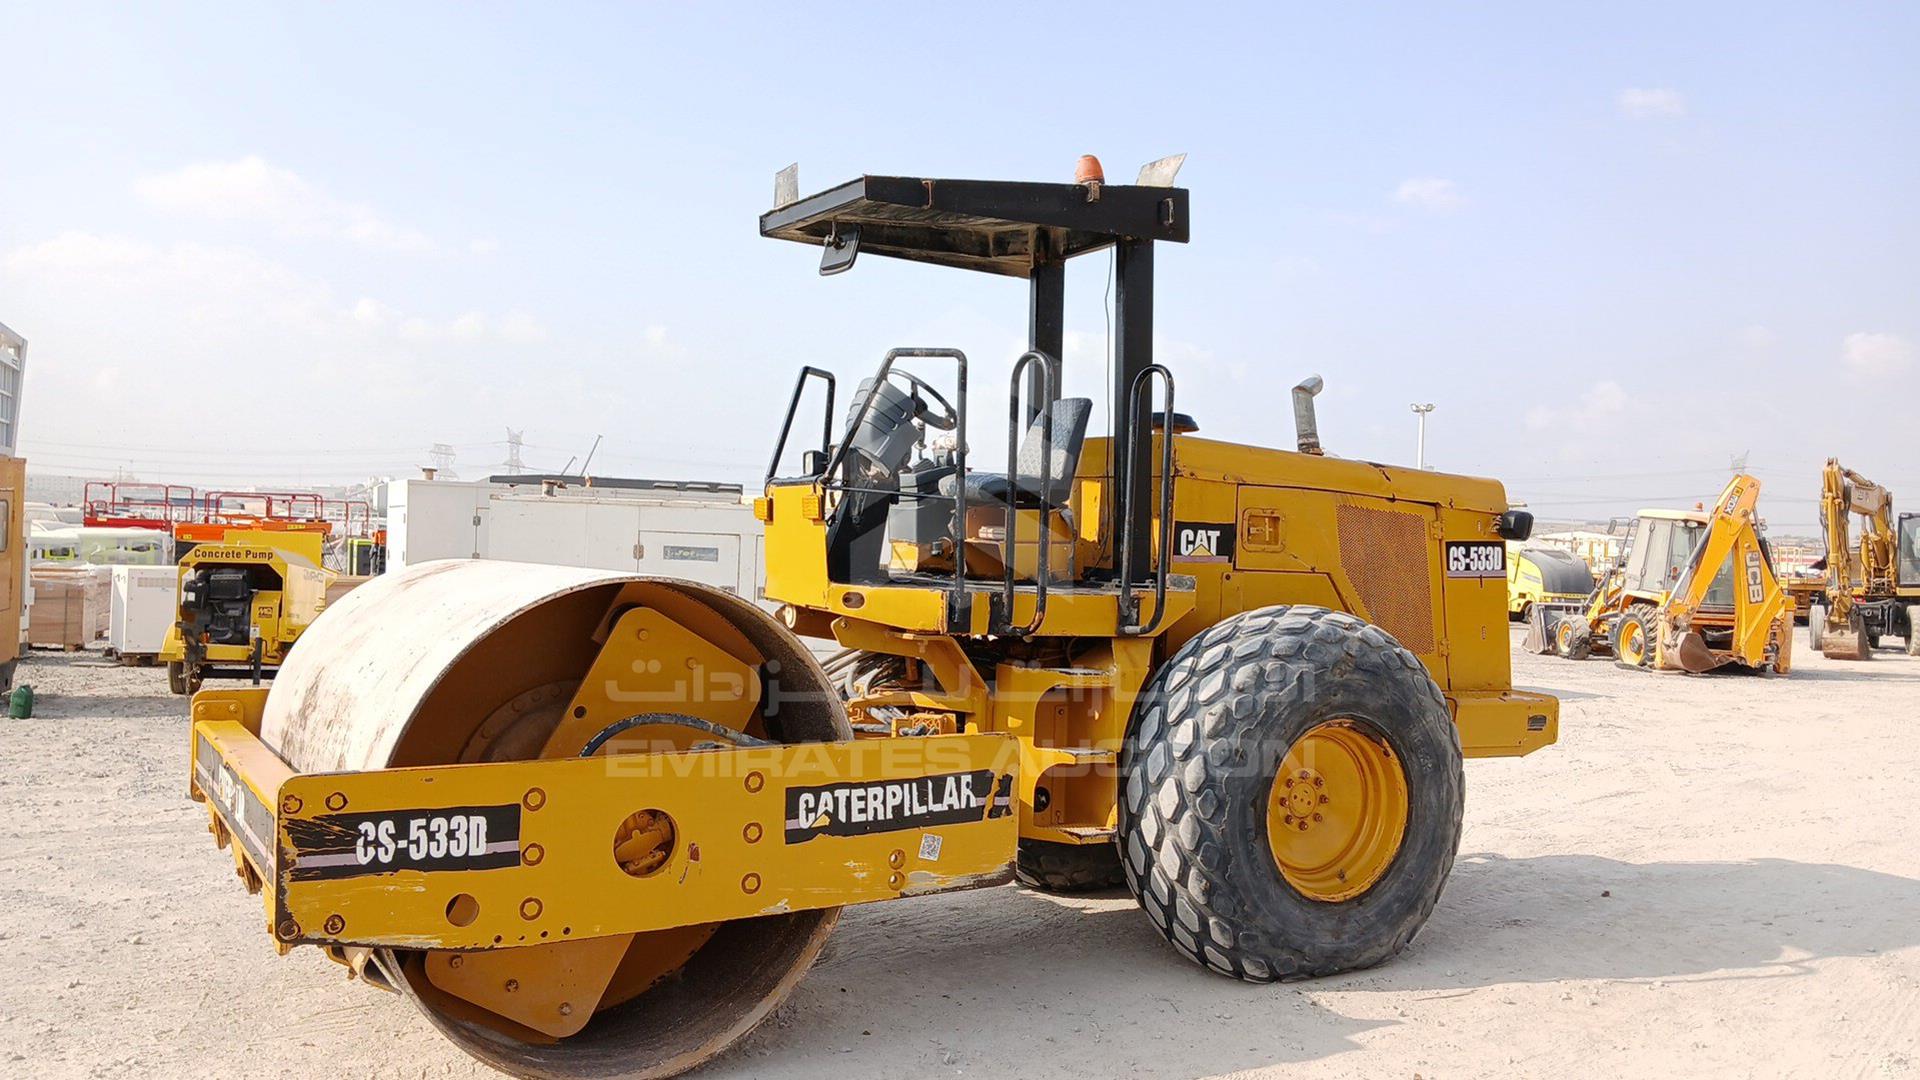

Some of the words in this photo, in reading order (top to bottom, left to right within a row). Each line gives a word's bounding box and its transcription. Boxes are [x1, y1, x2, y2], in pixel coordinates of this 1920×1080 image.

[194, 549, 241, 559] Concrete
[245, 550, 273, 560] Pump
[1181, 529, 1220, 556] CAT
[1449, 546, 1502, 571] CS-533D
[1746, 551, 1763, 604] JCB
[799, 774, 977, 829] CATERPILLAR
[356, 815, 487, 865] CS-533D
